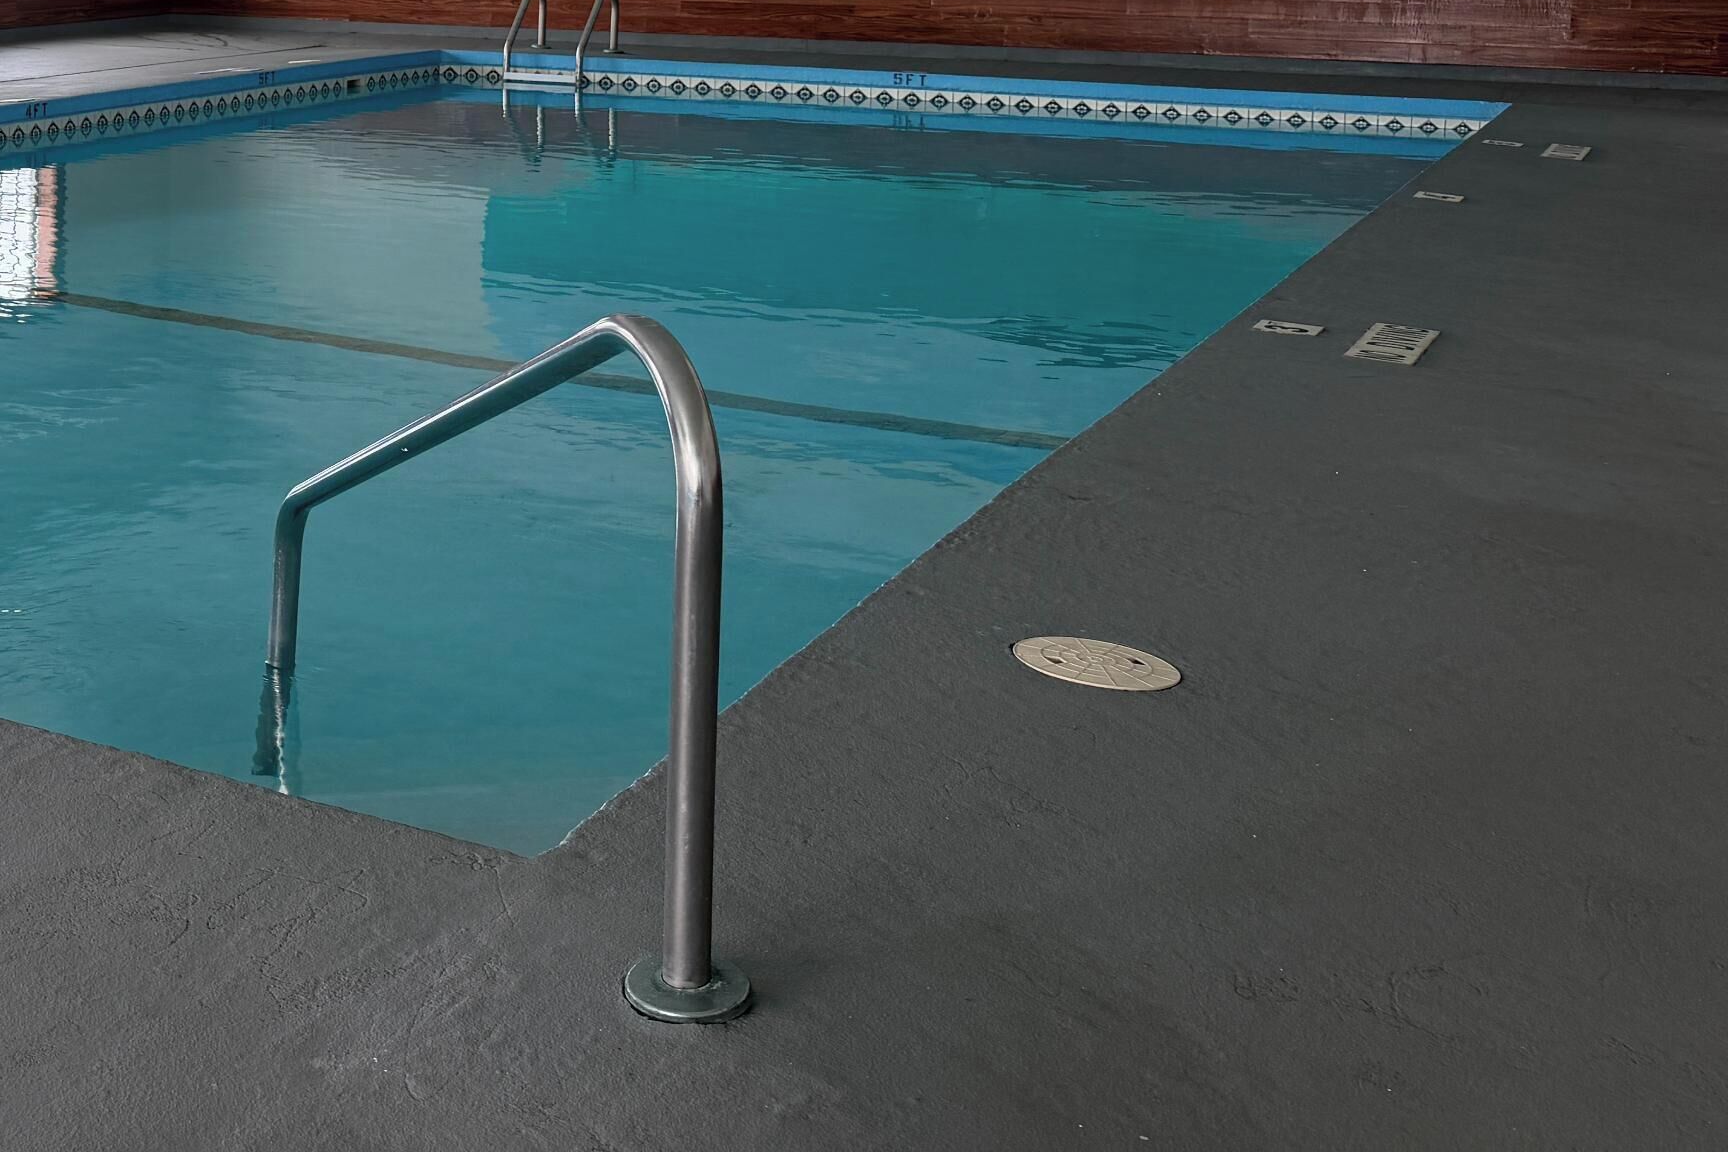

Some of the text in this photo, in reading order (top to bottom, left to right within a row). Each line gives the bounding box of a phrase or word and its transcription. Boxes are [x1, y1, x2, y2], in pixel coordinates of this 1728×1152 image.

[893, 73, 927, 86] 5FT
[26, 102, 48, 119] 4FT
[1366, 324, 1430, 350] DIVING
